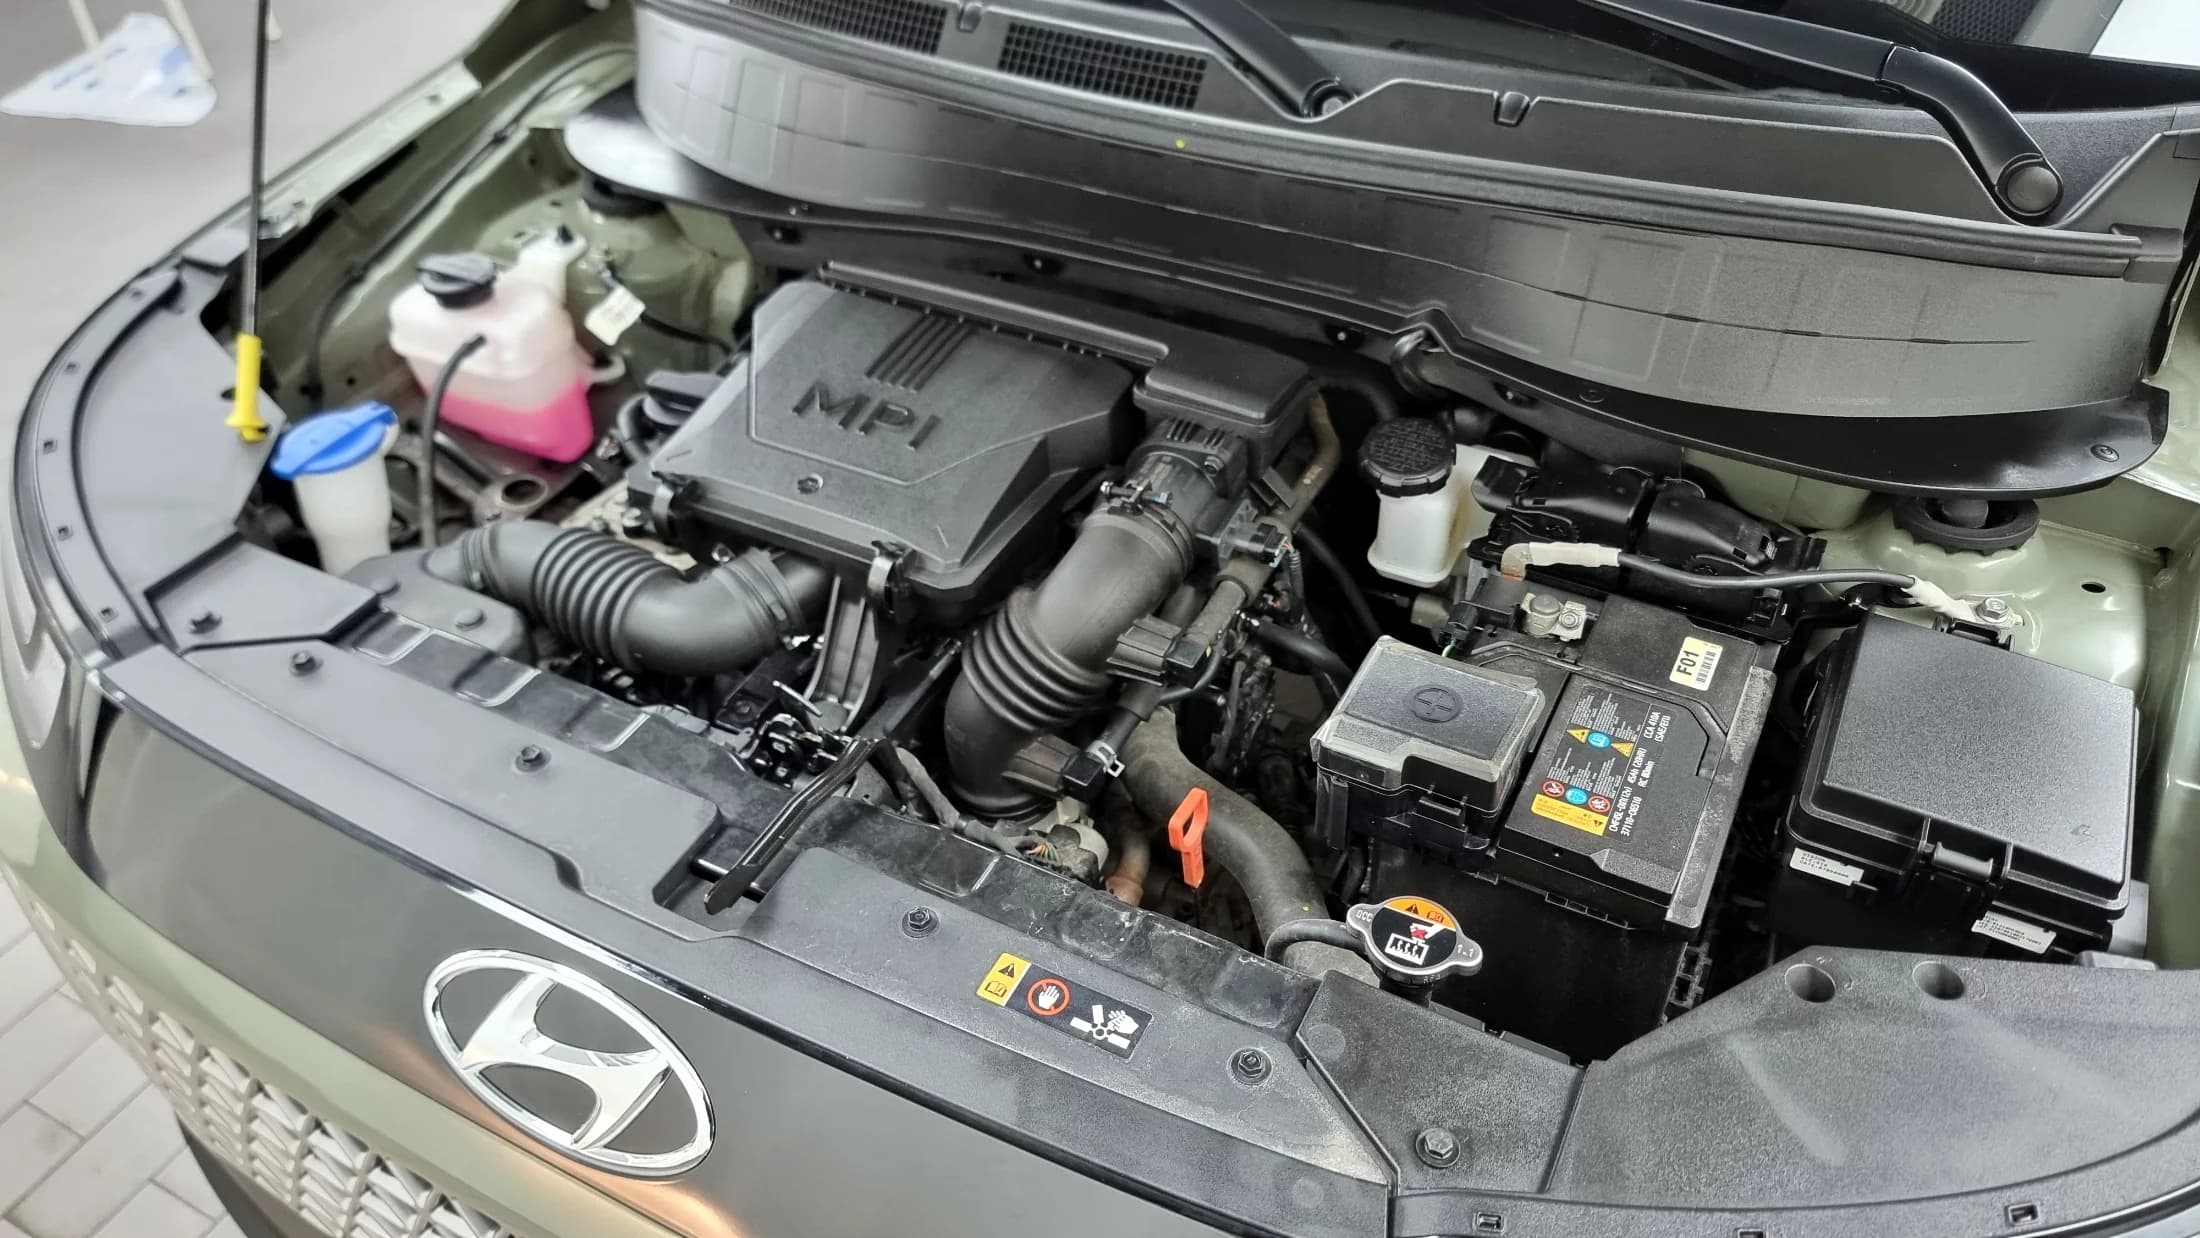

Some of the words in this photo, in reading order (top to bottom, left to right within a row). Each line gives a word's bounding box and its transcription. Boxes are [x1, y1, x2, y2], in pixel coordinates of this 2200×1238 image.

[790, 380, 943, 451] MPI
[1676, 650, 1700, 676] F01
[1643, 727, 1656, 739] CCA
[1457, 943, 1474, 958] 1.1
